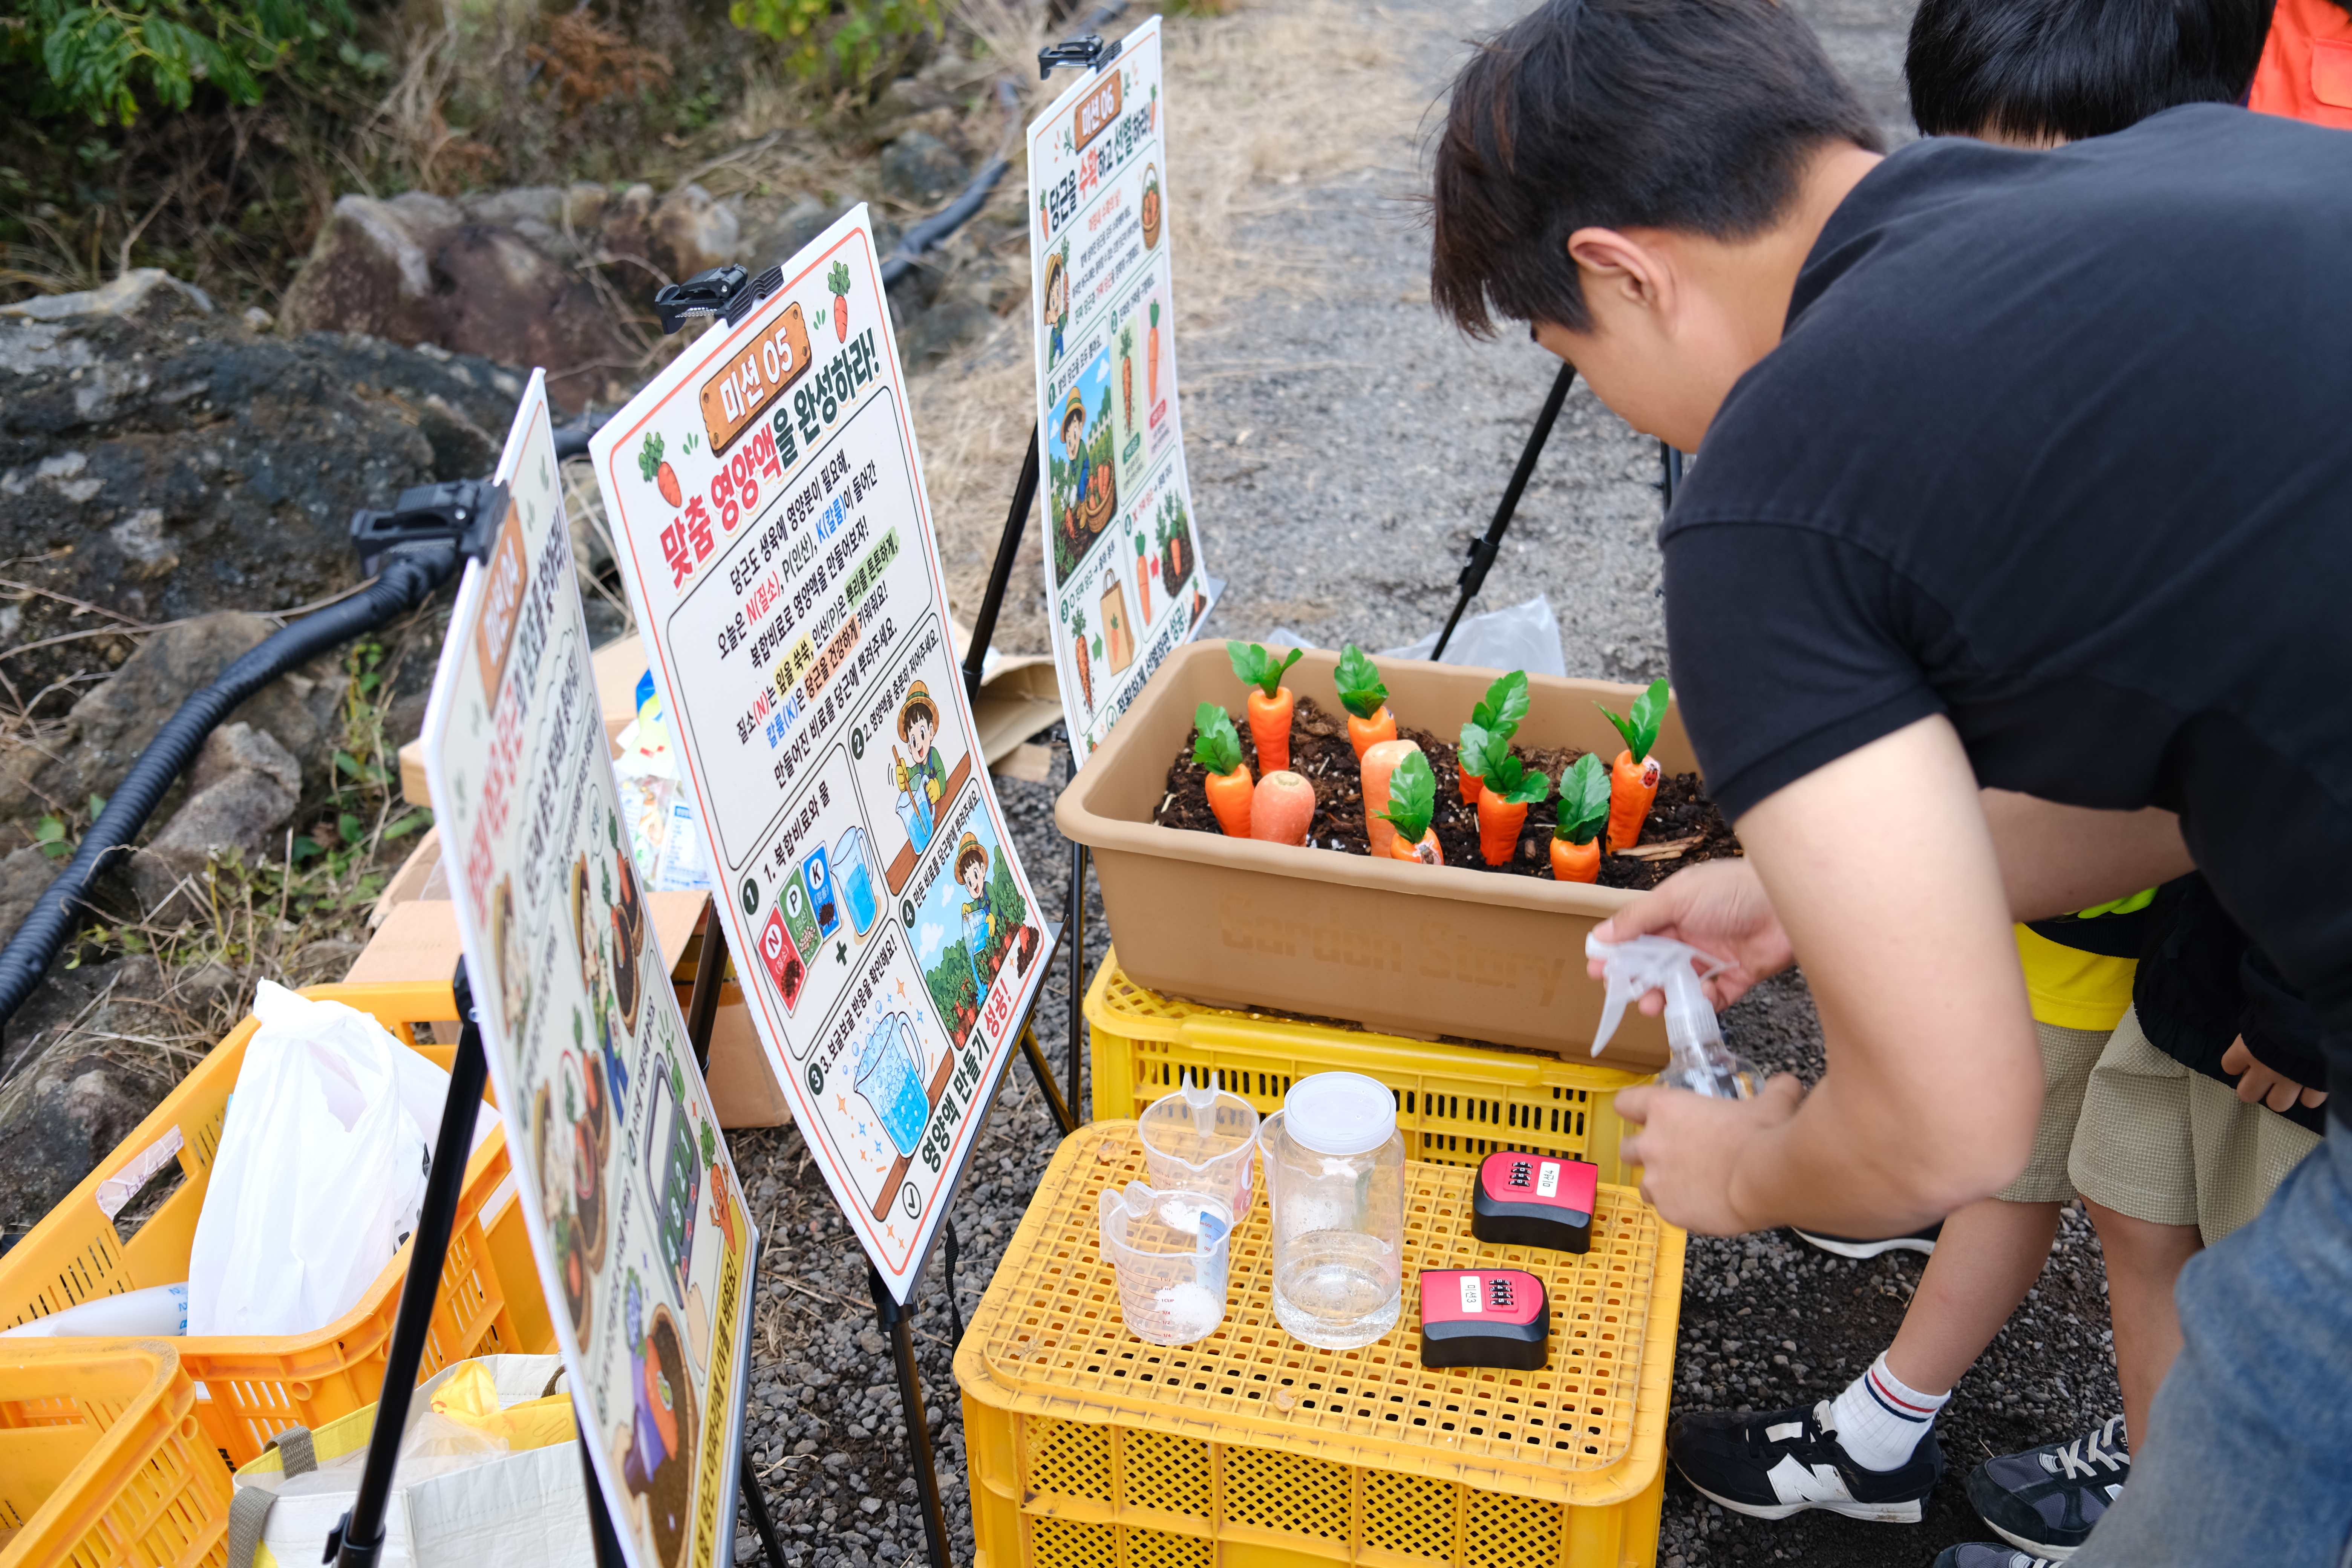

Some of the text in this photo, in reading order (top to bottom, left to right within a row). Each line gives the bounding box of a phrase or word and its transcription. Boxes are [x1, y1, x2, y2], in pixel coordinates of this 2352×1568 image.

[1082, 84, 1114, 136] 미션 06
[1050, 170, 1076, 232] 당근을
[1080, 139, 1113, 200] 수확하고
[720, 327, 792, 423] 미션 05
[1068, 358, 1079, 383] 당근을
[1081, 349, 1088, 368] 모두
[660, 327, 879, 589] 맞춤 영양액을 완성하라!
[718, 459, 877, 660] 오늘은 N(질소), P(인산), K(칼륨)이 들어간
[730, 449, 850, 596] 당근도 생육에 영양분이 필요해.
[750, 515, 868, 668] 복합비료로 영양액을 만들어보자!
[1076, 581, 1084, 601] 진짜
[1084, 570, 1093, 590] 당근
[737, 533, 897, 744] 질소(N)는 잎을 쑥쑥, 인산(P)은 뿌리를 튼튼하게,
[766, 580, 888, 749] 칼륨(K)은 당근을 건강하게 키워줘요!
[864, 629, 938, 742] 2. 영양액을 충분히 저어주세요.
[1146, 628, 1171, 678] 선별하면
[1170, 602, 1187, 641] 성공!
[775, 617, 897, 789] 만들어진 비료를 당근에 뿌려주세요.
[764, 780, 830, 883] 1. 복합비료와 물
[812, 862, 821, 885] K
[913, 790, 980, 909] 만든 비료를 당근밭에 뿌려주세요.
[768, 929, 779, 953] N
[789, 890, 797, 913] P
[821, 934, 897, 1074] 3. 보글보글 반응을 확인해요!
[922, 978, 1011, 1173] 영양액 만들기 성공!
[675, 1161, 686, 1193] 2
[680, 1129, 689, 1153] 1
[671, 1197, 681, 1228] 8
[722, 1242, 737, 1326] 비춰요!
[717, 1317, 730, 1382] UV를
